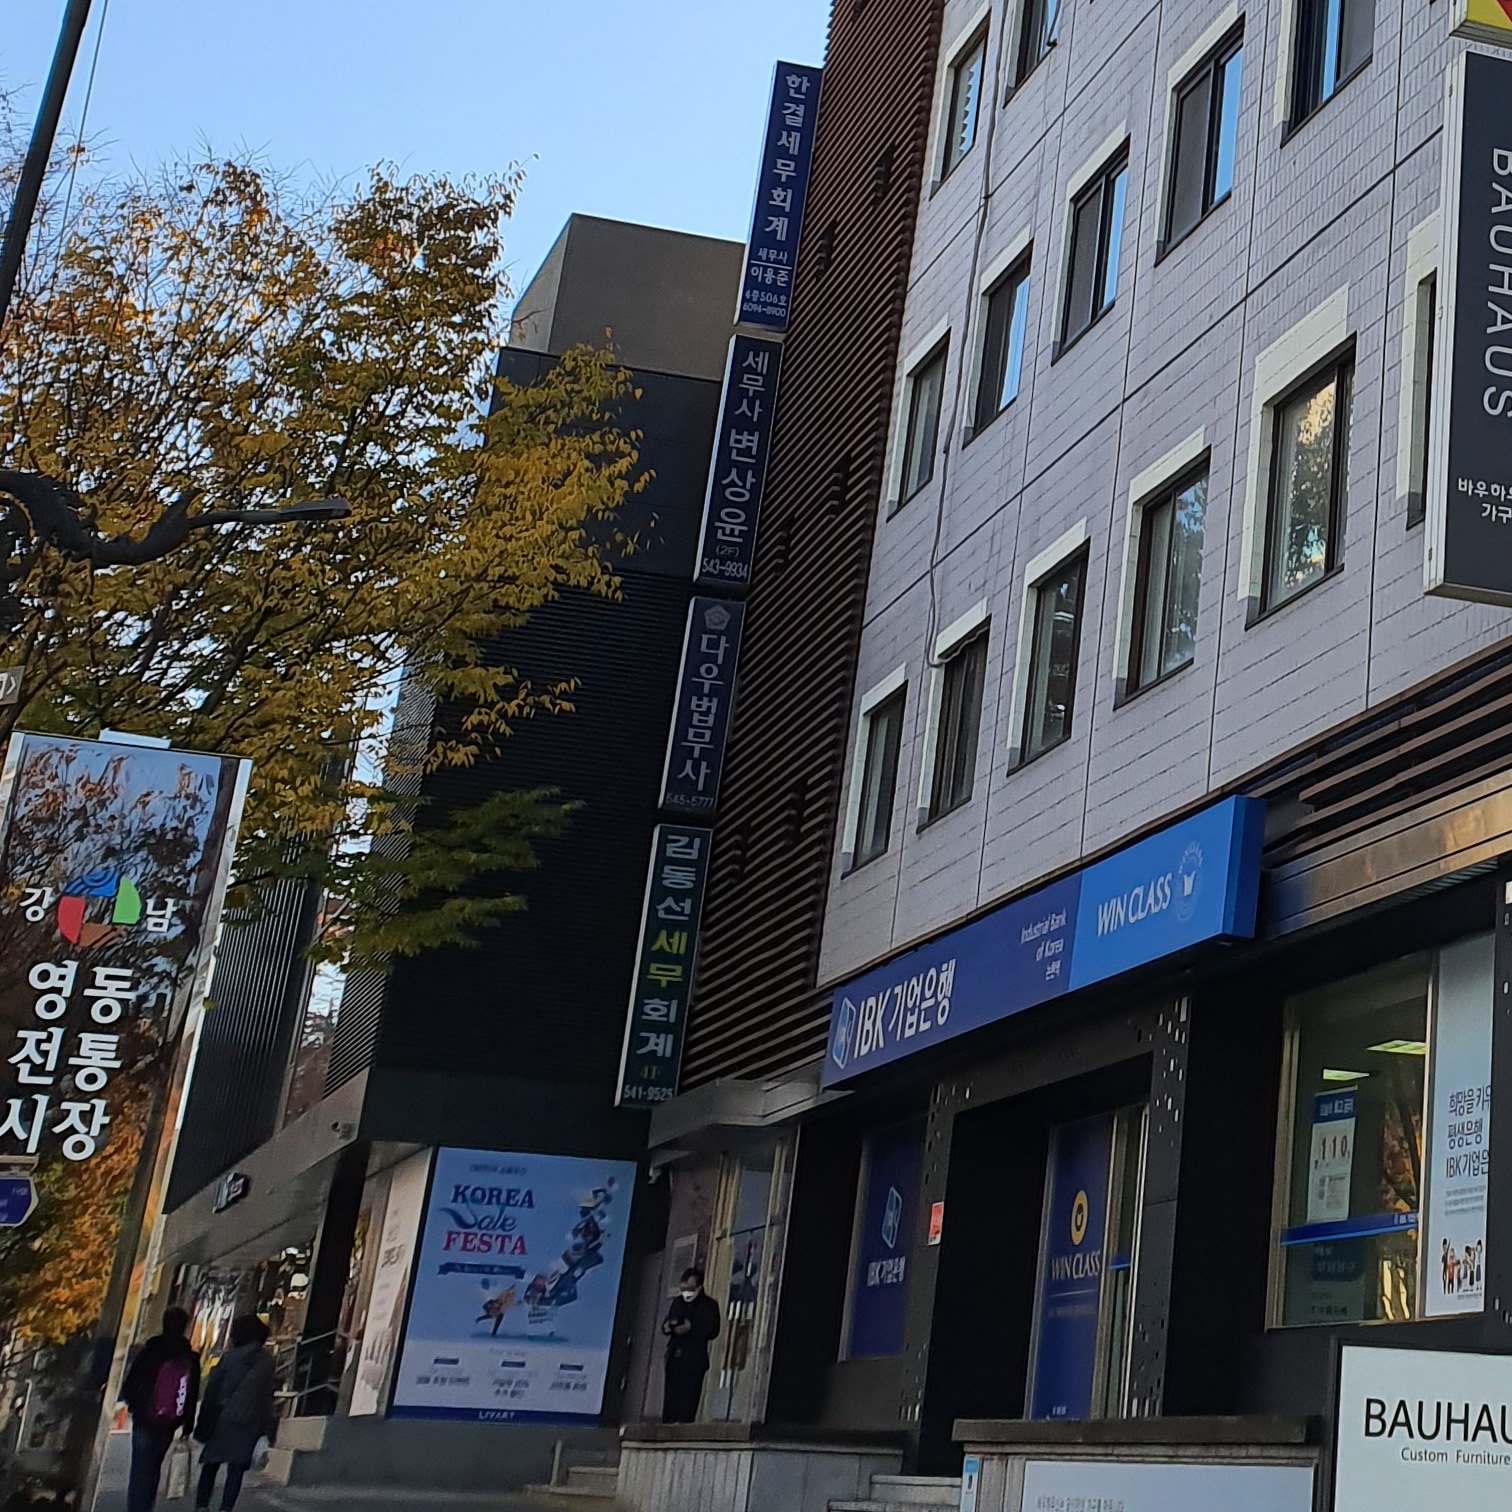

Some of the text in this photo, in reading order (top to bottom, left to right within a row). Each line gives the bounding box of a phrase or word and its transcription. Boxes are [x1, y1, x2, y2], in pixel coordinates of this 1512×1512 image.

[714, 351, 770, 543] 세무사 변상윤
[1481, 503, 1512, 524] 가구
[676, 634, 731, 792] 다우법무사
[1098, 872, 1173, 937] WIN CLASS
[28, 959, 136, 1025] 영동
[854, 959, 956, 1059] IBK 기업은행
[8, 1027, 123, 1092] 전통
[0, 1094, 111, 1161] 시장
[451, 1184, 535, 1208] KOREA
[443, 1230, 528, 1255] FESTA
[1052, 1251, 1100, 1280] WIN CLASS
[1401, 1447, 1512, 1466] Custom Furniture
